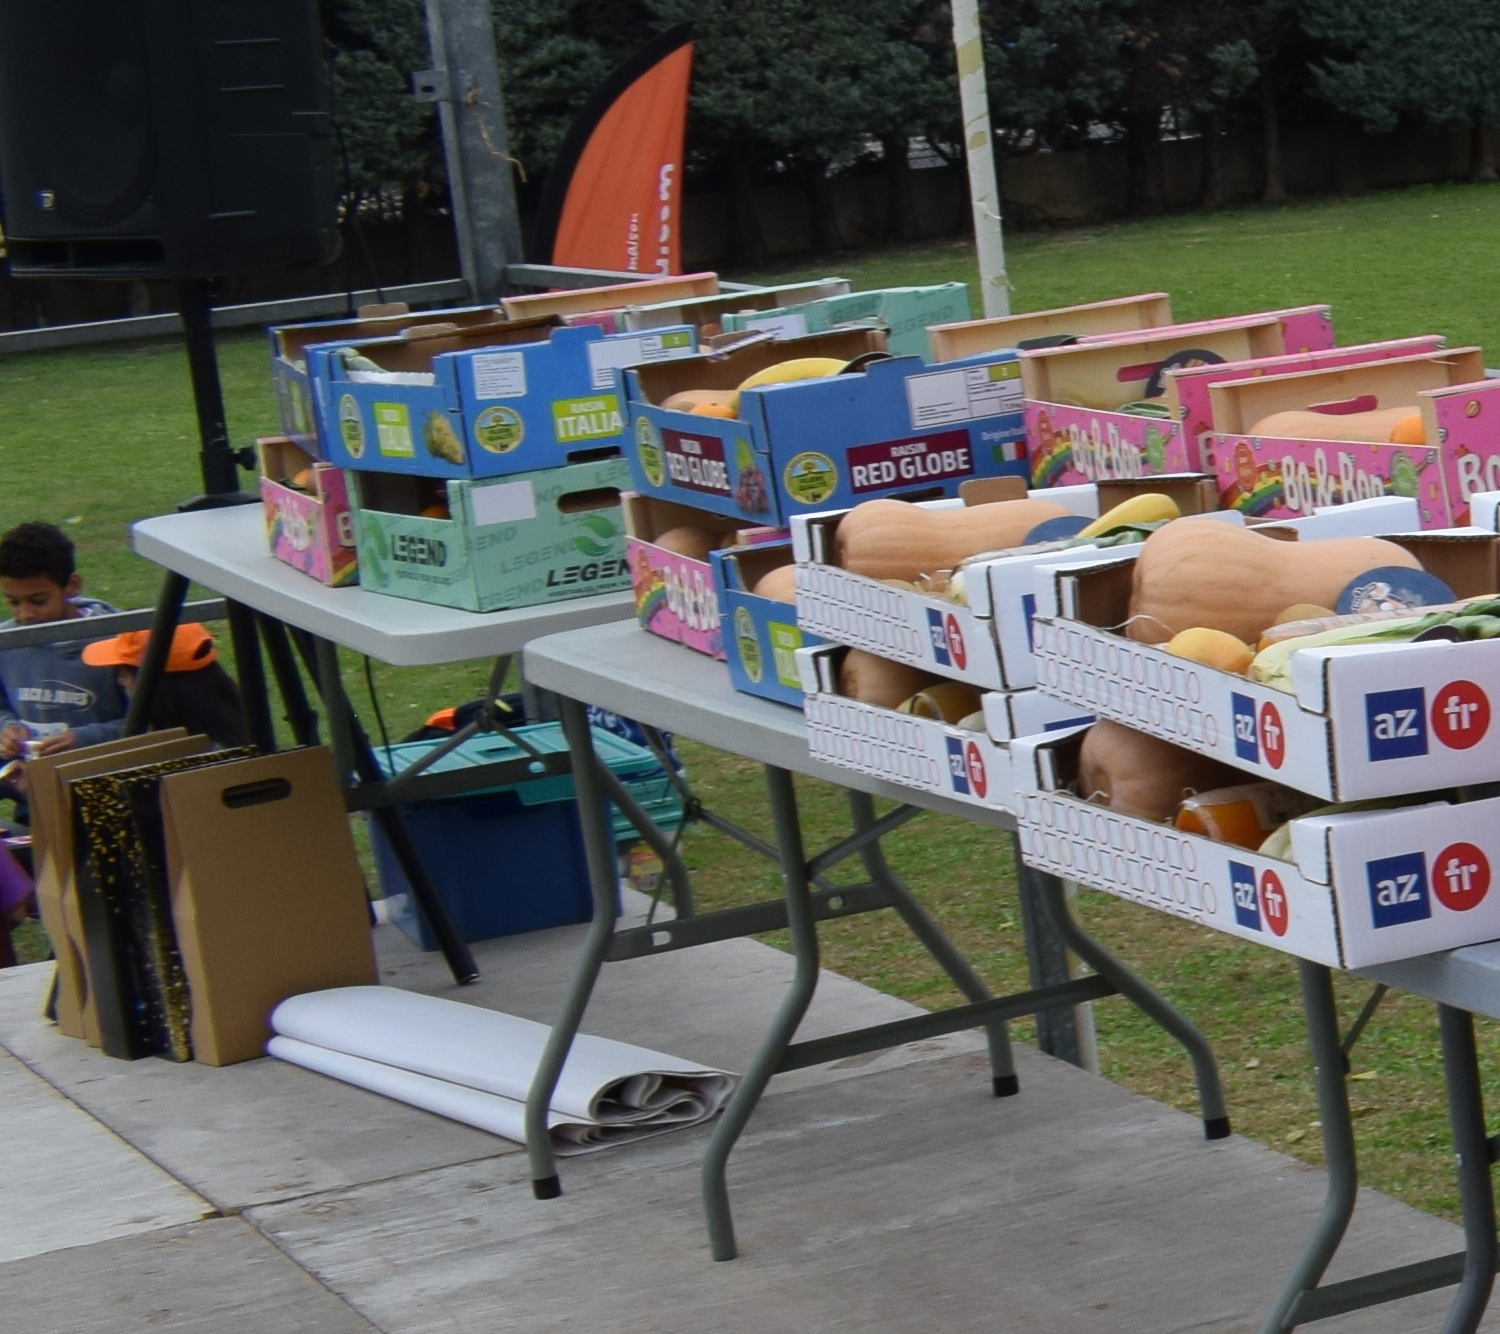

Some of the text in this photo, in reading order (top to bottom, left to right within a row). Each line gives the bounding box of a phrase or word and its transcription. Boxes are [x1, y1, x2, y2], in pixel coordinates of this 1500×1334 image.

[557, 412, 623, 438] ITALIA
[852, 462, 897, 488] RED
[898, 448, 970, 480] GLOBE
[546, 559, 632, 587] LEGEN
[1235, 714, 1281, 750] az fr
[1373, 708, 1419, 740] az
[1443, 695, 1479, 731] fr
[1376, 873, 1421, 907] az
[1443, 858, 1479, 894] fr
[1233, 883, 1281, 919] az fr
